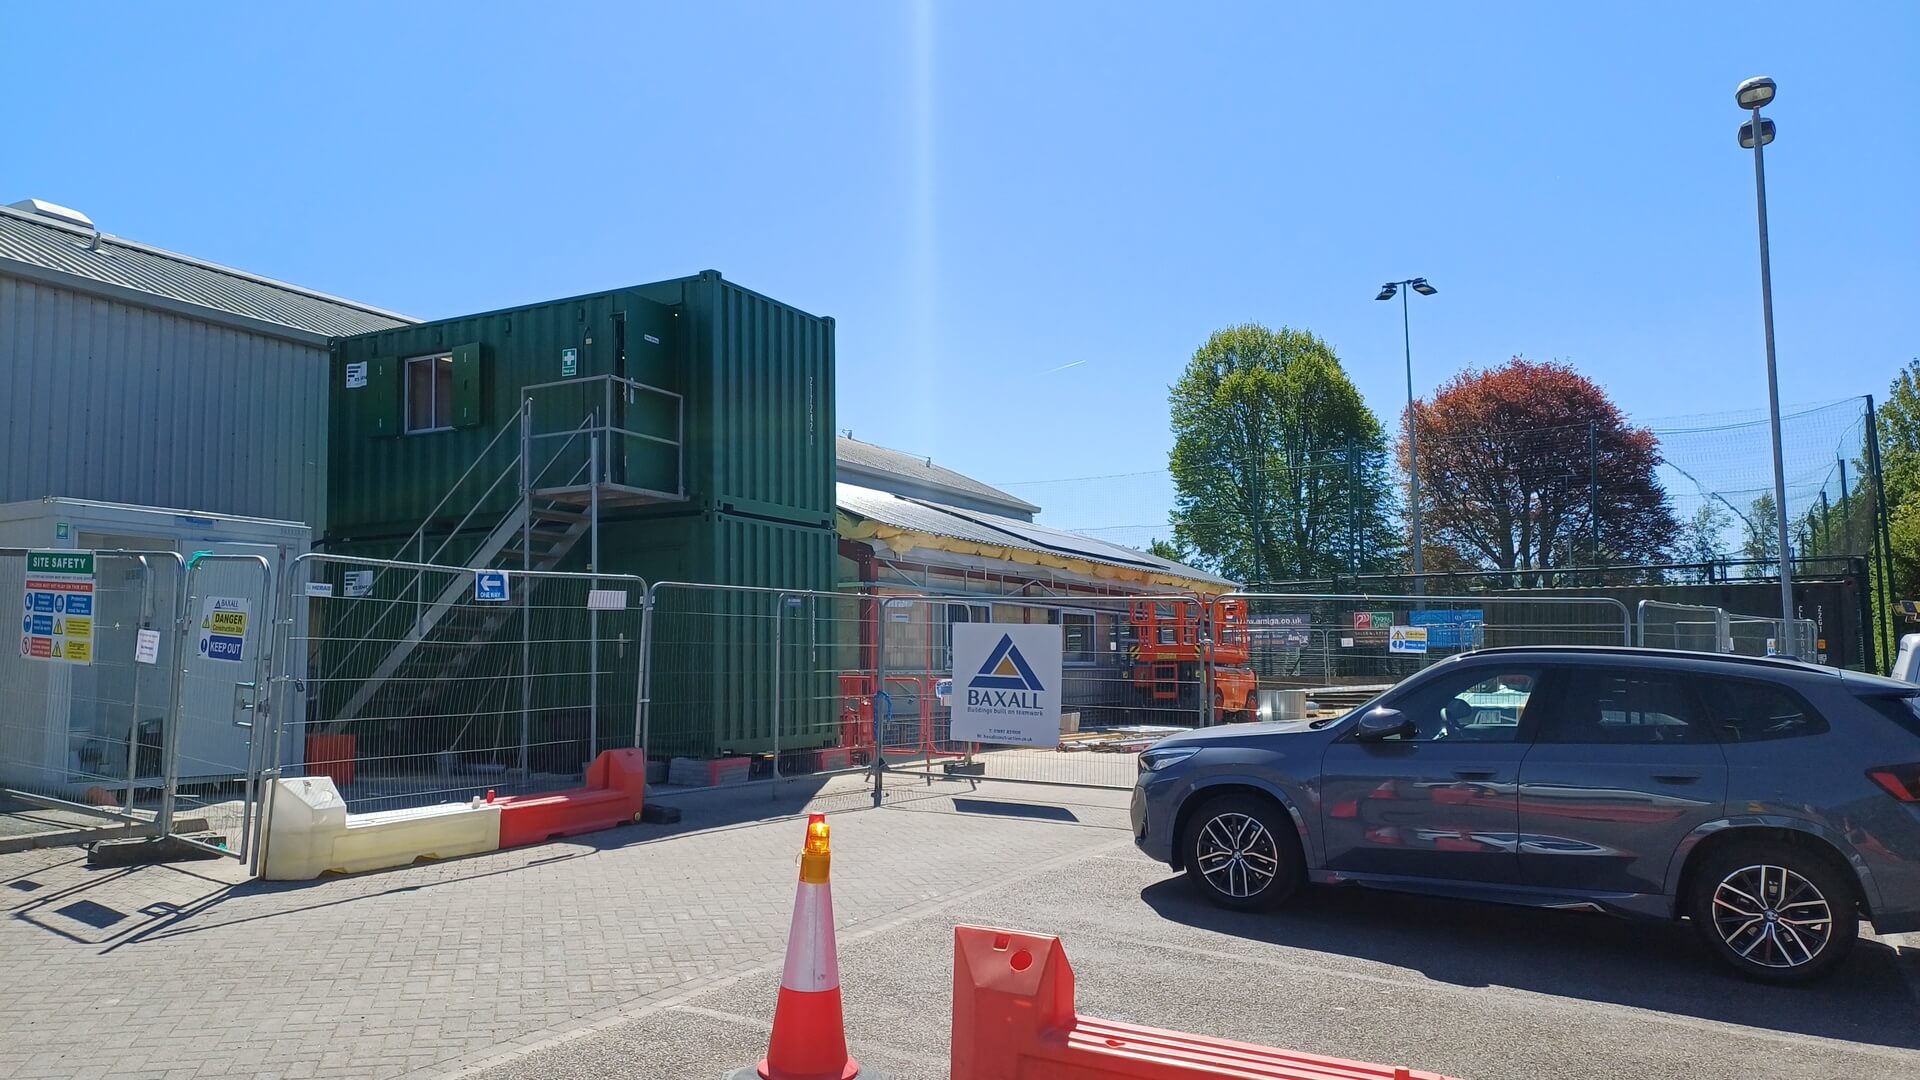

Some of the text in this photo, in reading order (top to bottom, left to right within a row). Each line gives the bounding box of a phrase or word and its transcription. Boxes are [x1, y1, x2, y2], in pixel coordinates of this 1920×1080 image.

[33, 557, 86, 569] SITE SAFETY
[215, 613, 243, 625] DANGER
[210, 642, 240, 654] KEEP OUT
[967, 689, 1044, 709] BAXALL
[967, 707, 992, 715] Buildings
